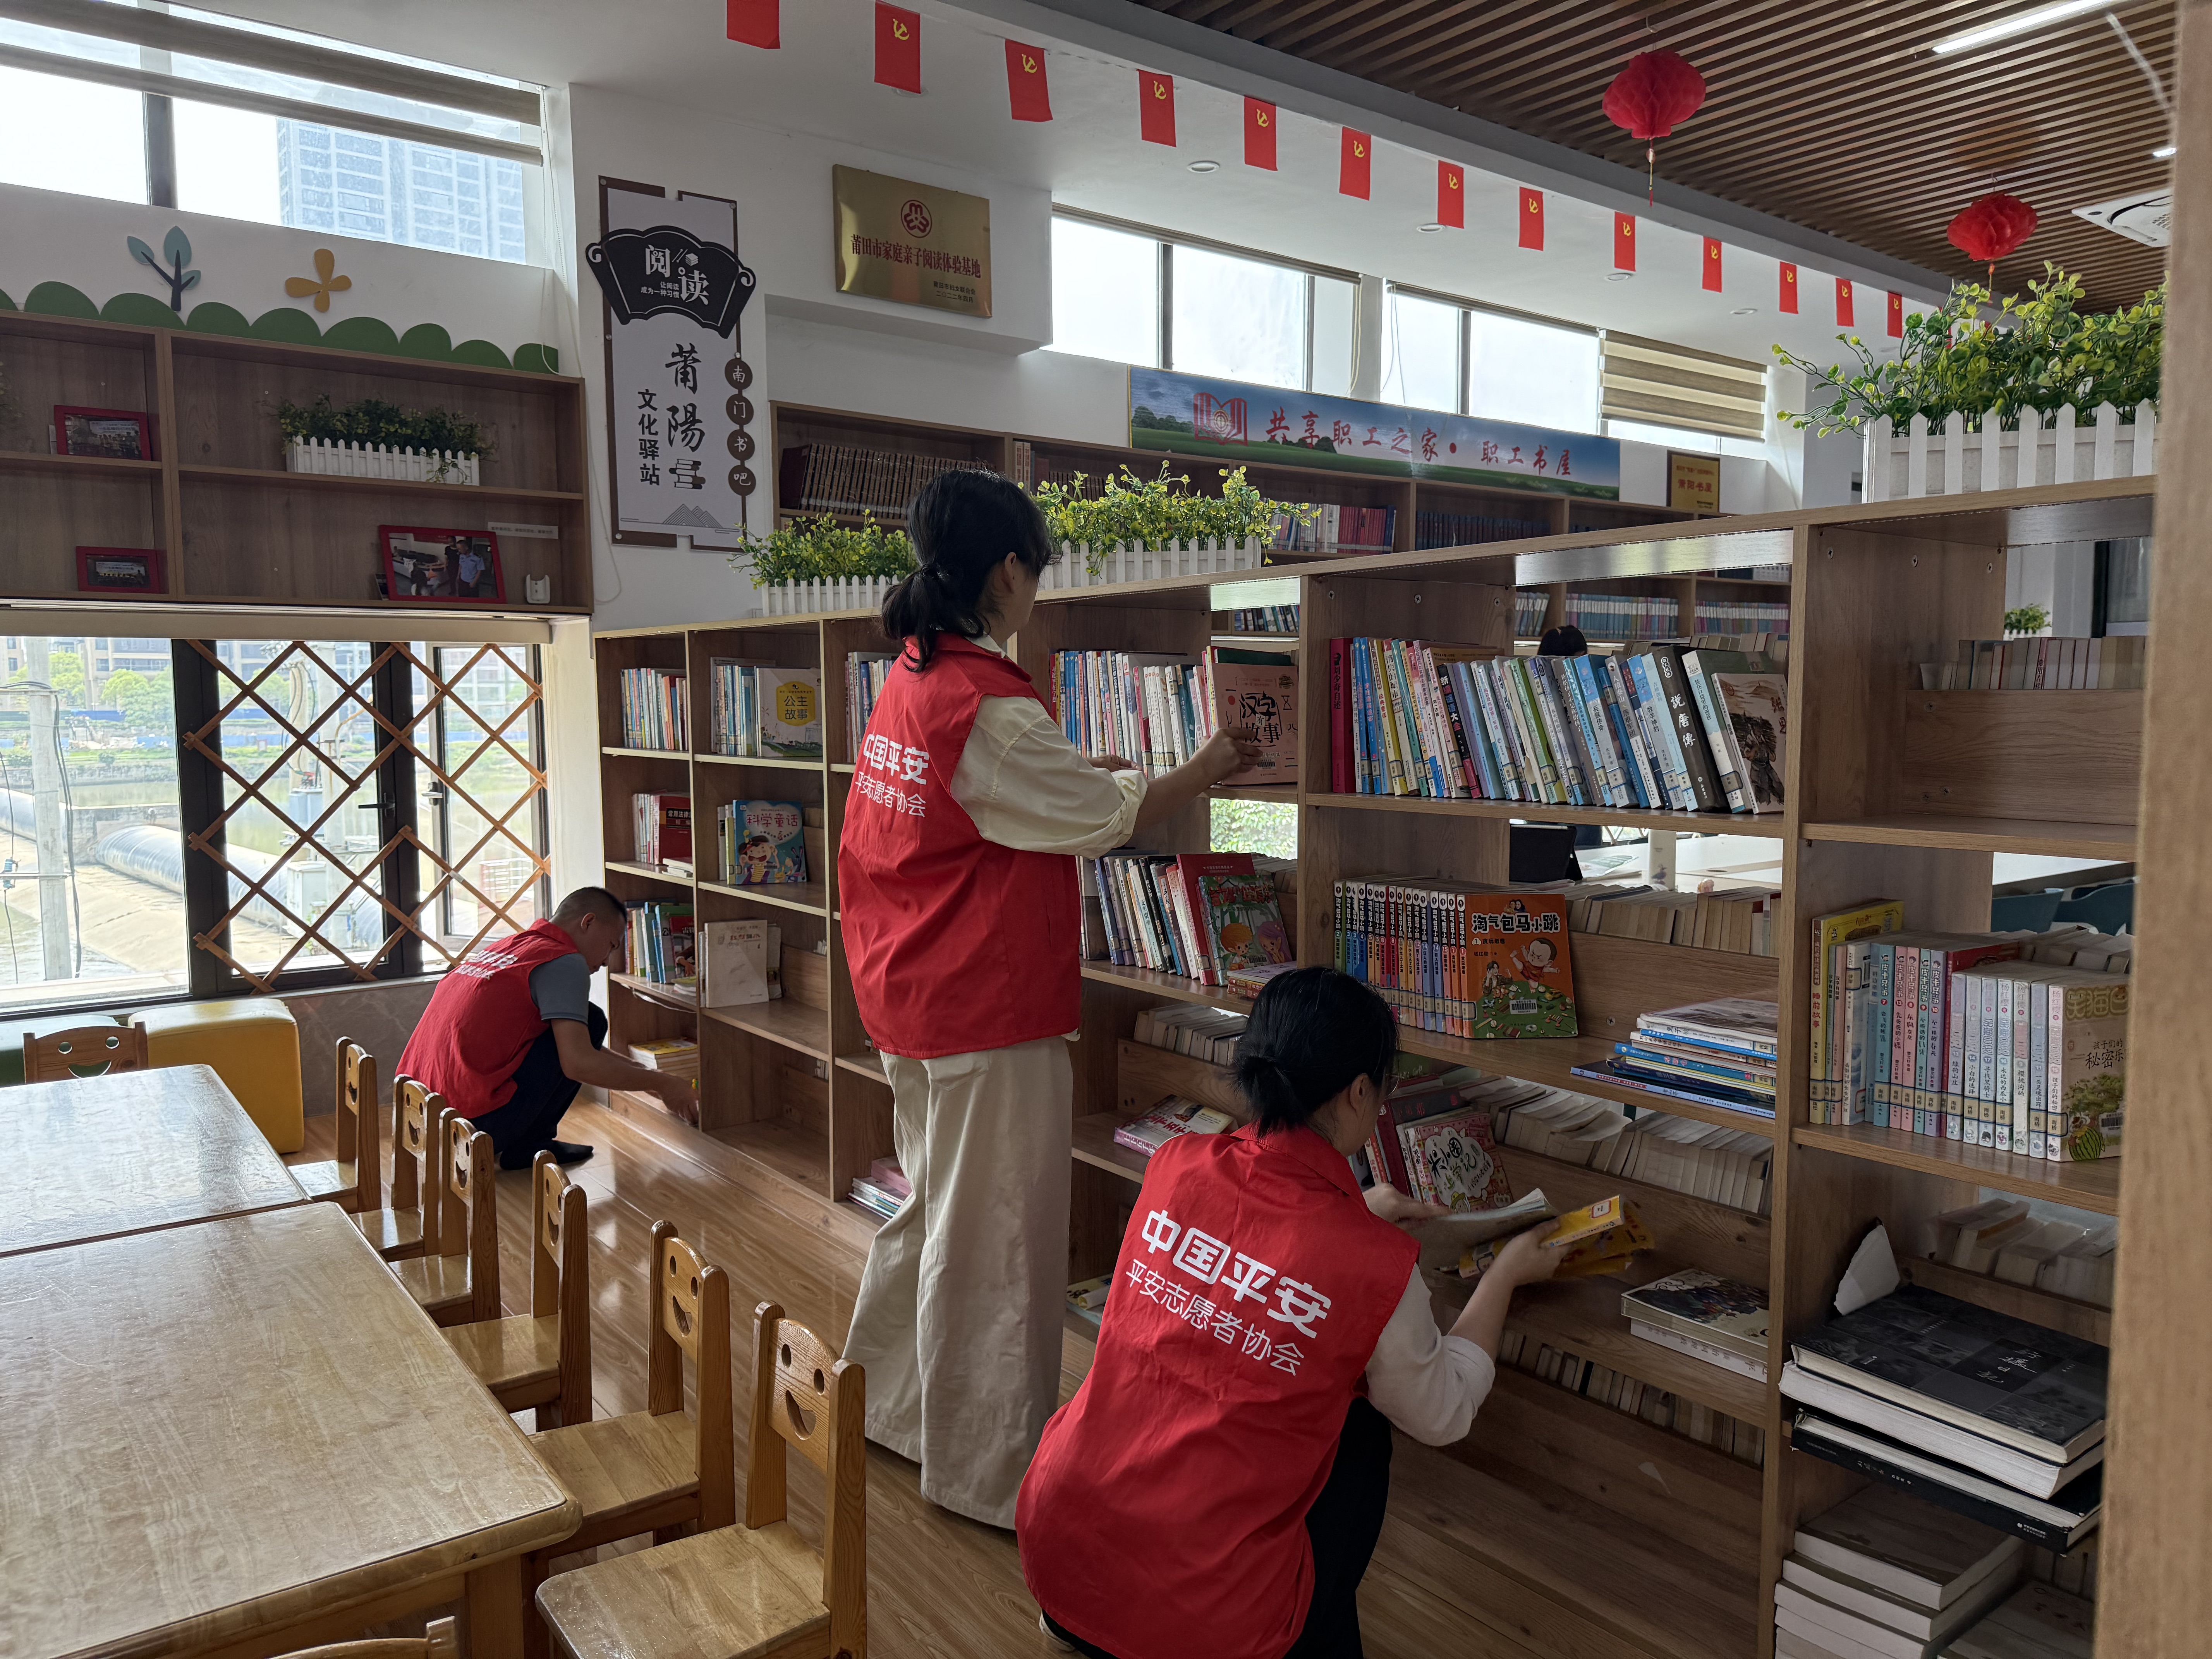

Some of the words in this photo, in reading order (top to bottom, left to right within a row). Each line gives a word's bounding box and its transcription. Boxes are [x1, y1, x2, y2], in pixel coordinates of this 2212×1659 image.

[851, 234, 981, 278] 莆田市家庭亲子阅读体验基地
[645, 244, 709, 305] 阅读
[637, 388, 659, 486] 文化驿站
[732, 365, 750, 485] 南门书吧
[1482, 440, 1572, 477] 职工书屋
[784, 696, 807, 706] 公主
[785, 709, 808, 720] 故事
[1239, 691, 1277, 721] 汉字
[1257, 716, 1264, 725] 有
[863, 733, 929, 785] 中国平安
[855, 771, 926, 817] 平安志愿者协会
[668, 810, 691, 818] 常用法律
[746, 814, 798, 827] 科学童话
[1472, 912, 1560, 933] 淘气包马小跳
[2085, 1049, 2126, 1070] 秘密乐
[2093, 1038, 2123, 1049] 孩子们的
[1142, 1209, 1331, 1339] 中国平安
[1126, 1259, 1304, 1376] 平安志愿者协会
